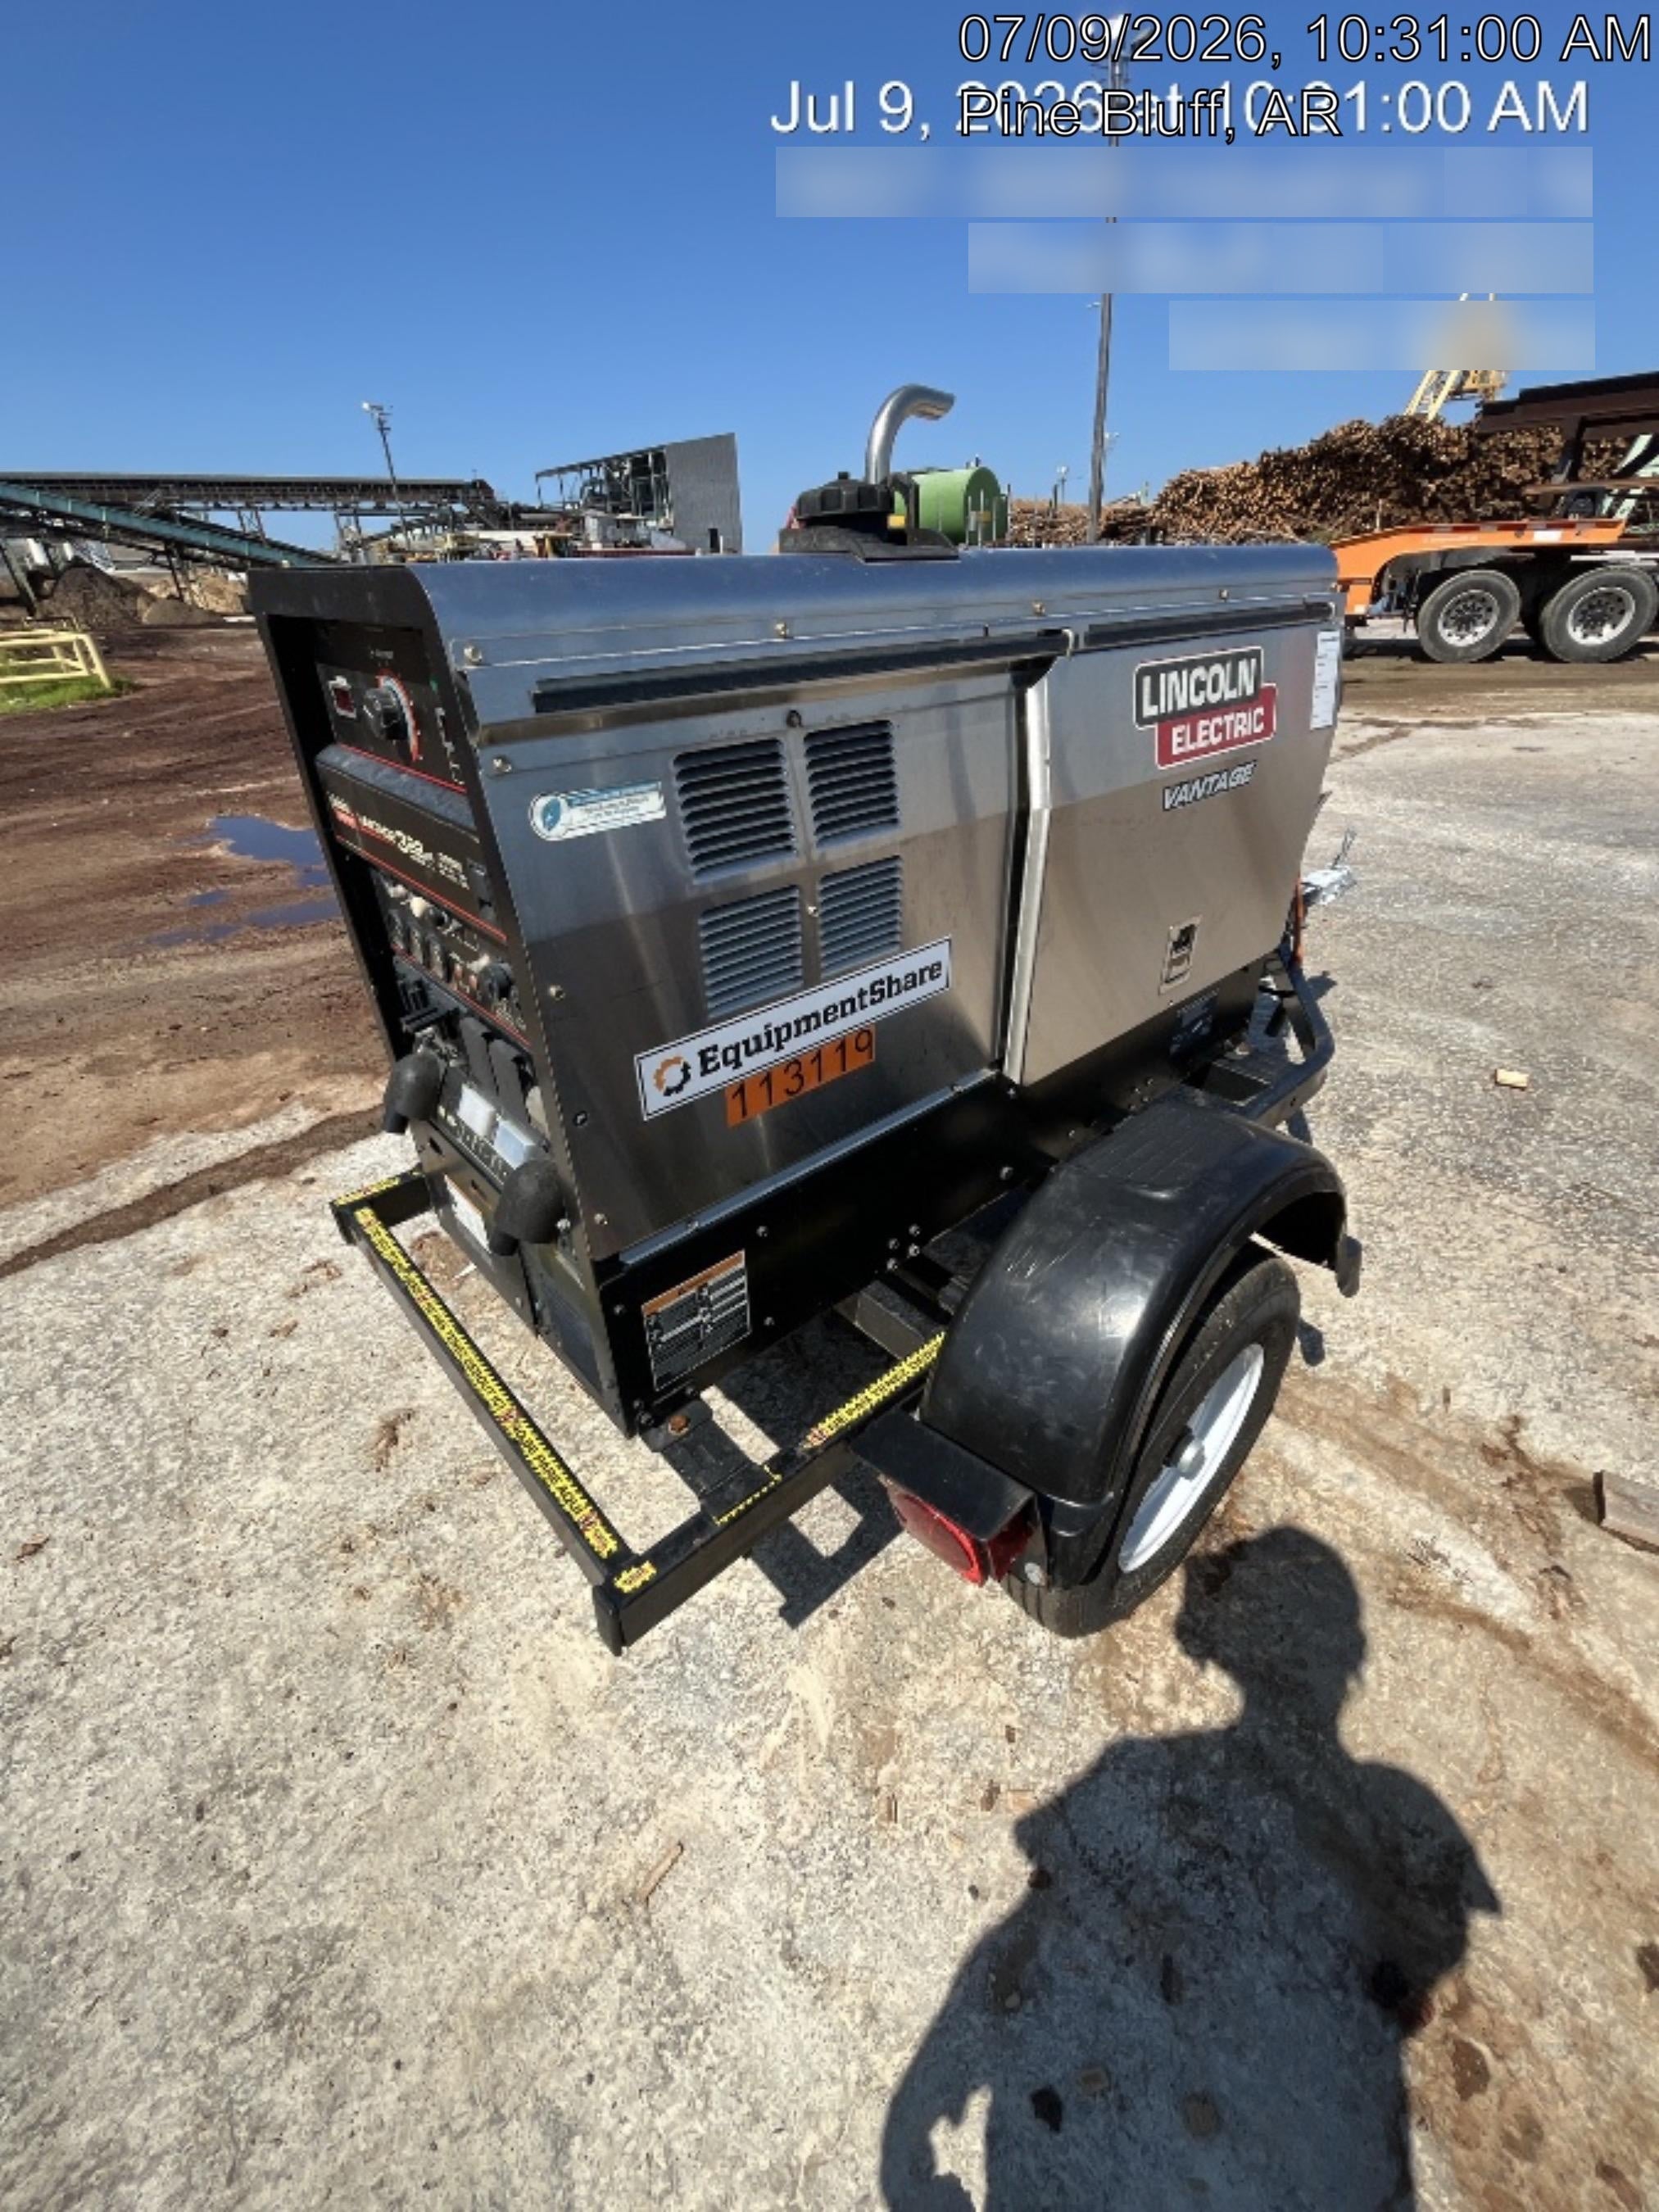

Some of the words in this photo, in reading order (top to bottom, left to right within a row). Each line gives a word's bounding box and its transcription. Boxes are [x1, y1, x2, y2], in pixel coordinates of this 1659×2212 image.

[1142, 658, 1258, 718] LINCOLN
[1172, 707, 1264, 755] ELECTRIC
[1163, 760, 1255, 811] VANTAGE
[696, 959, 943, 1077] EquipmentShare
[731, 1028, 873, 1119] 113119
